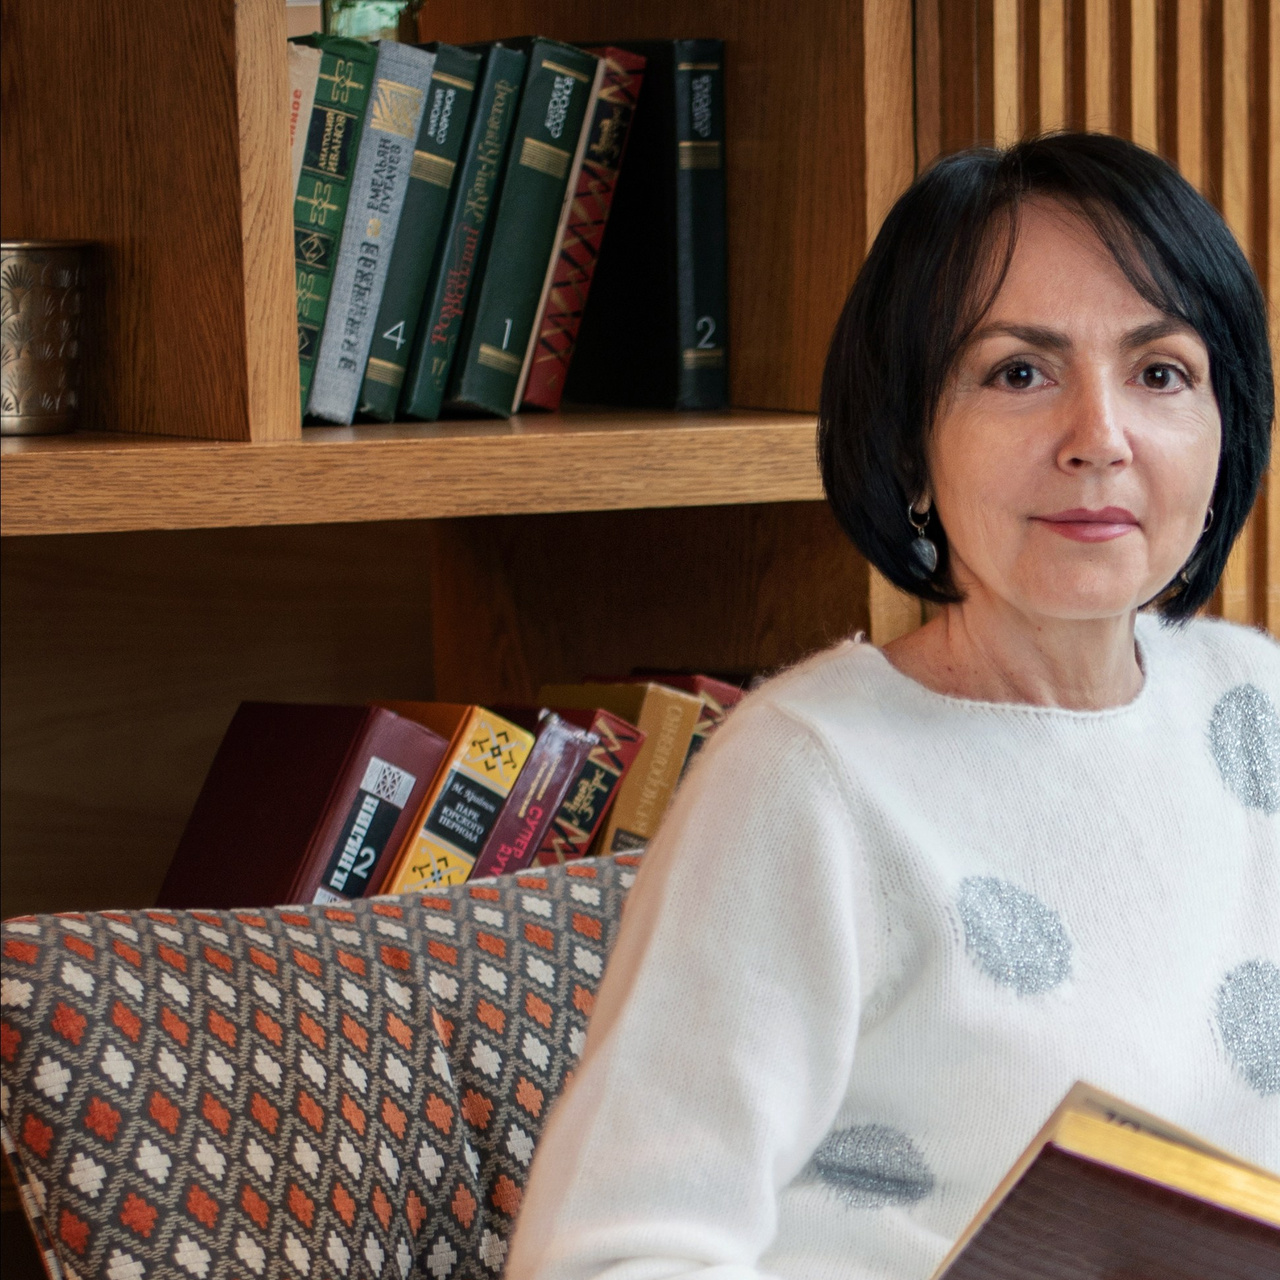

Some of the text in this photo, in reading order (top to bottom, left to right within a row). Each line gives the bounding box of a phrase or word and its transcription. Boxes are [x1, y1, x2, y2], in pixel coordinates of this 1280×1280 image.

[318, 110, 336, 170] АНАТОЛИЙ
[326, 114, 347, 173] ИВАНОВ
[366, 137, 392, 211] ЕМЕЛЬЯН
[378, 143, 402, 214] ПУГАЧЕВ
[382, 320, 406, 350] 4
[502, 318, 513, 351] 1
[695, 316, 718, 350] 2
[442, 805, 485, 836] ЮРСКОГО
[455, 802, 480, 822] ПАРК
[438, 815, 479, 844] ПЕРИОДА
[513, 805, 544, 859] СУПЕР
[352, 846, 376, 879] 2
